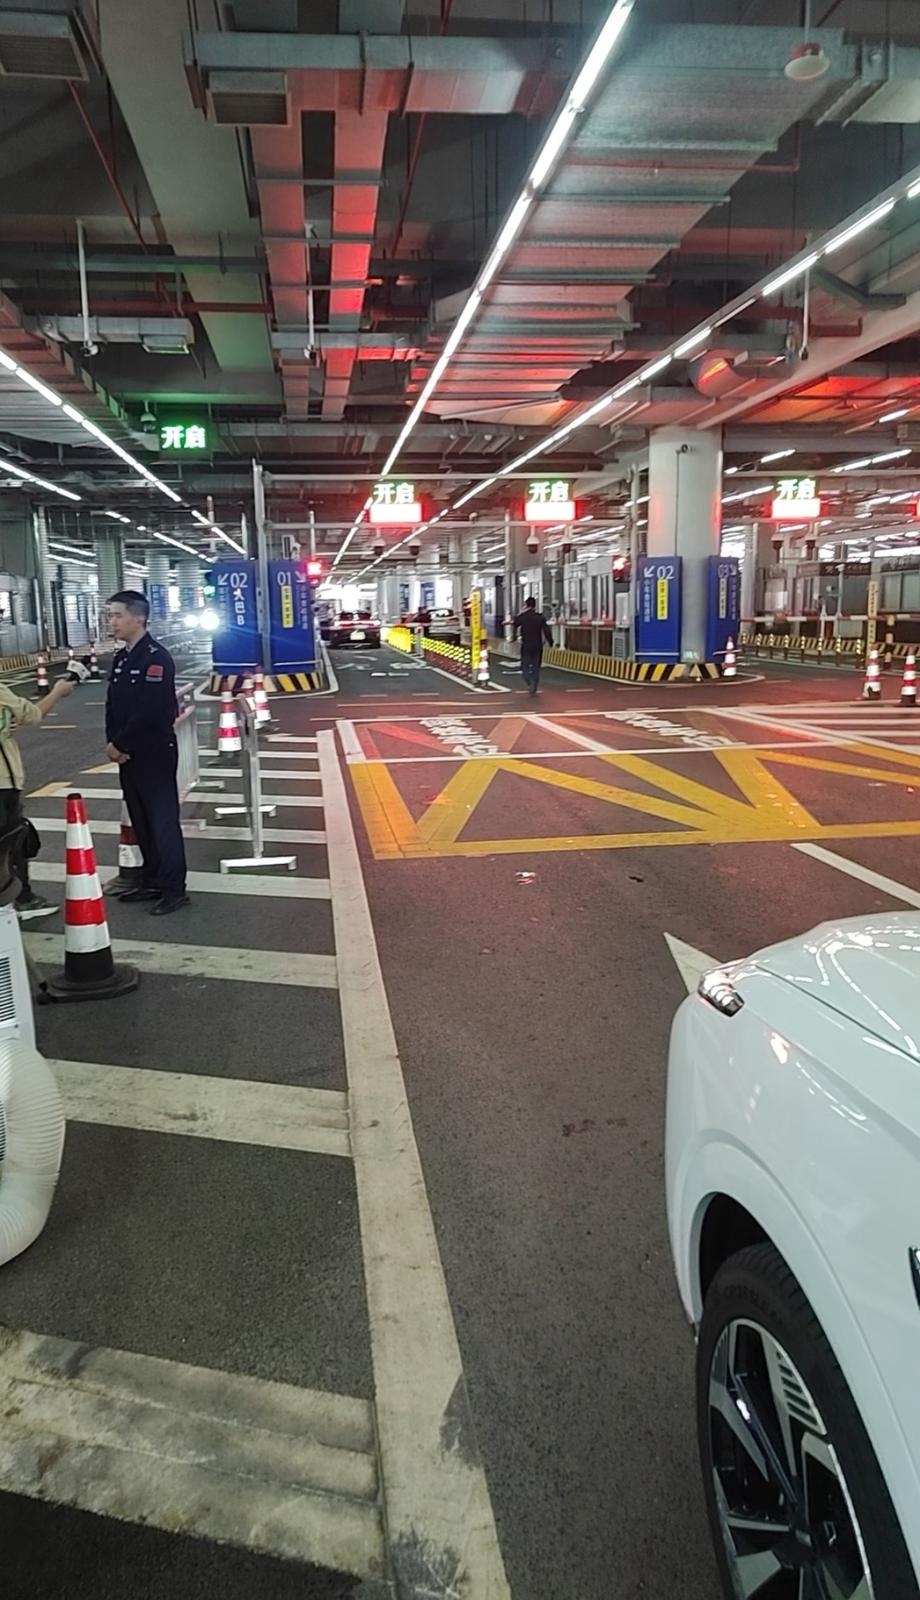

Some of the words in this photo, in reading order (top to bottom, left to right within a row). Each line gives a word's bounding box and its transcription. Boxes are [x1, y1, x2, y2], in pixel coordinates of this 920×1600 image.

[161, 424, 206, 449] 开启
[373, 483, 415, 504] 开启
[528, 481, 569, 503] 开启
[776, 478, 817, 500] 开启
[230, 572, 248, 588] 02
[277, 571, 292, 586] 01
[657, 565, 675, 580] 02
